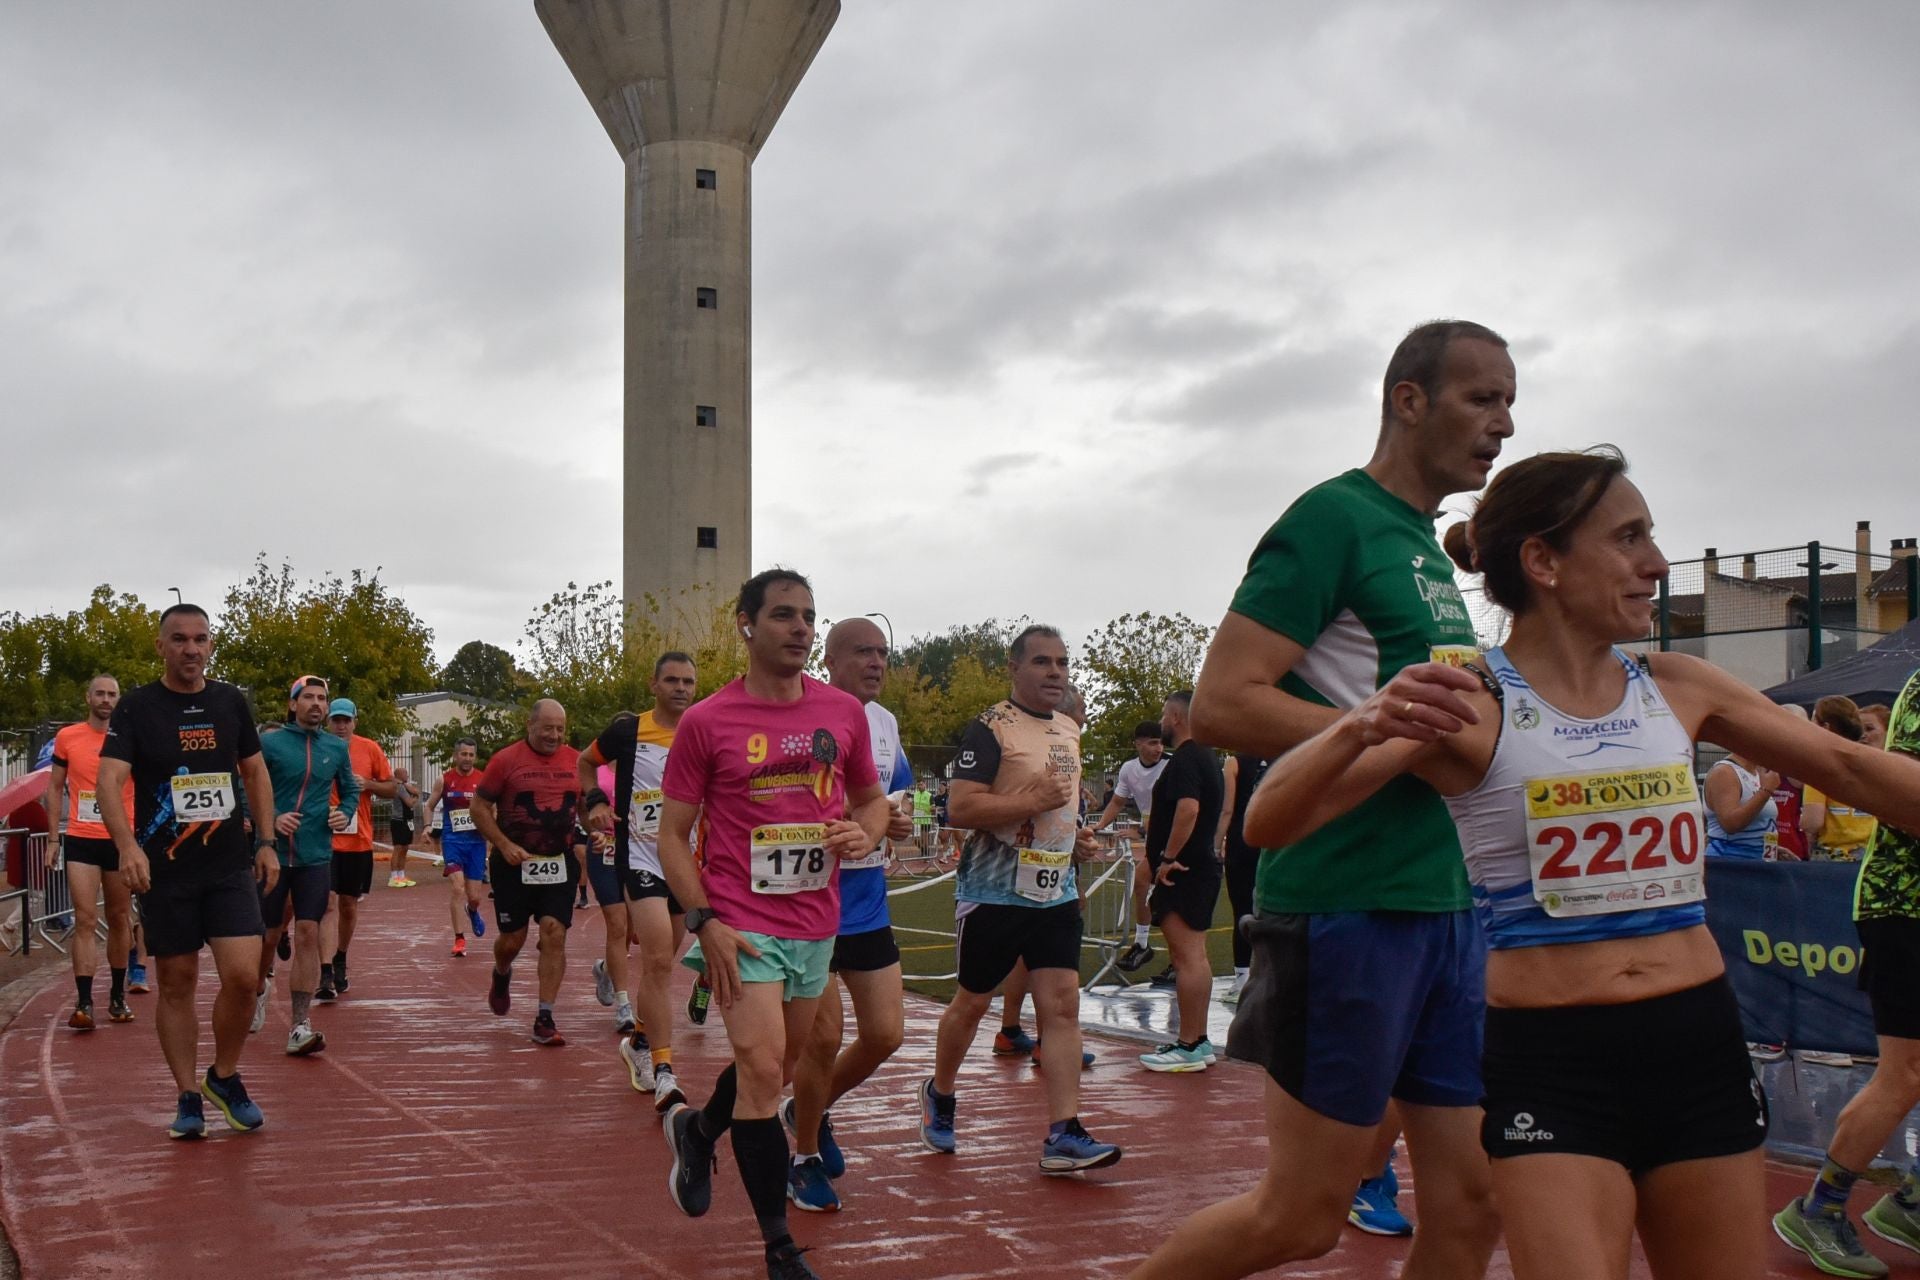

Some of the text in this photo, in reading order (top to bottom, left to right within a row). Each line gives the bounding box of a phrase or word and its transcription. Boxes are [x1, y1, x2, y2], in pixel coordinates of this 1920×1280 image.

[179, 729, 215, 739] FONDO
[1554, 719, 1639, 736] MARACENA
[180, 738, 216, 751] 2025
[746, 733, 768, 764] 9
[1588, 776, 1621, 788] GRAN
[1624, 771, 1662, 785] PREMIO
[183, 790, 224, 810] 251
[1553, 779, 1671, 806] 38 FONDO
[764, 828, 779, 840] 38
[1536, 812, 1698, 880] 2220
[529, 862, 559, 875] 249
[767, 847, 824, 875] 178
[1036, 869, 1059, 888] 69
